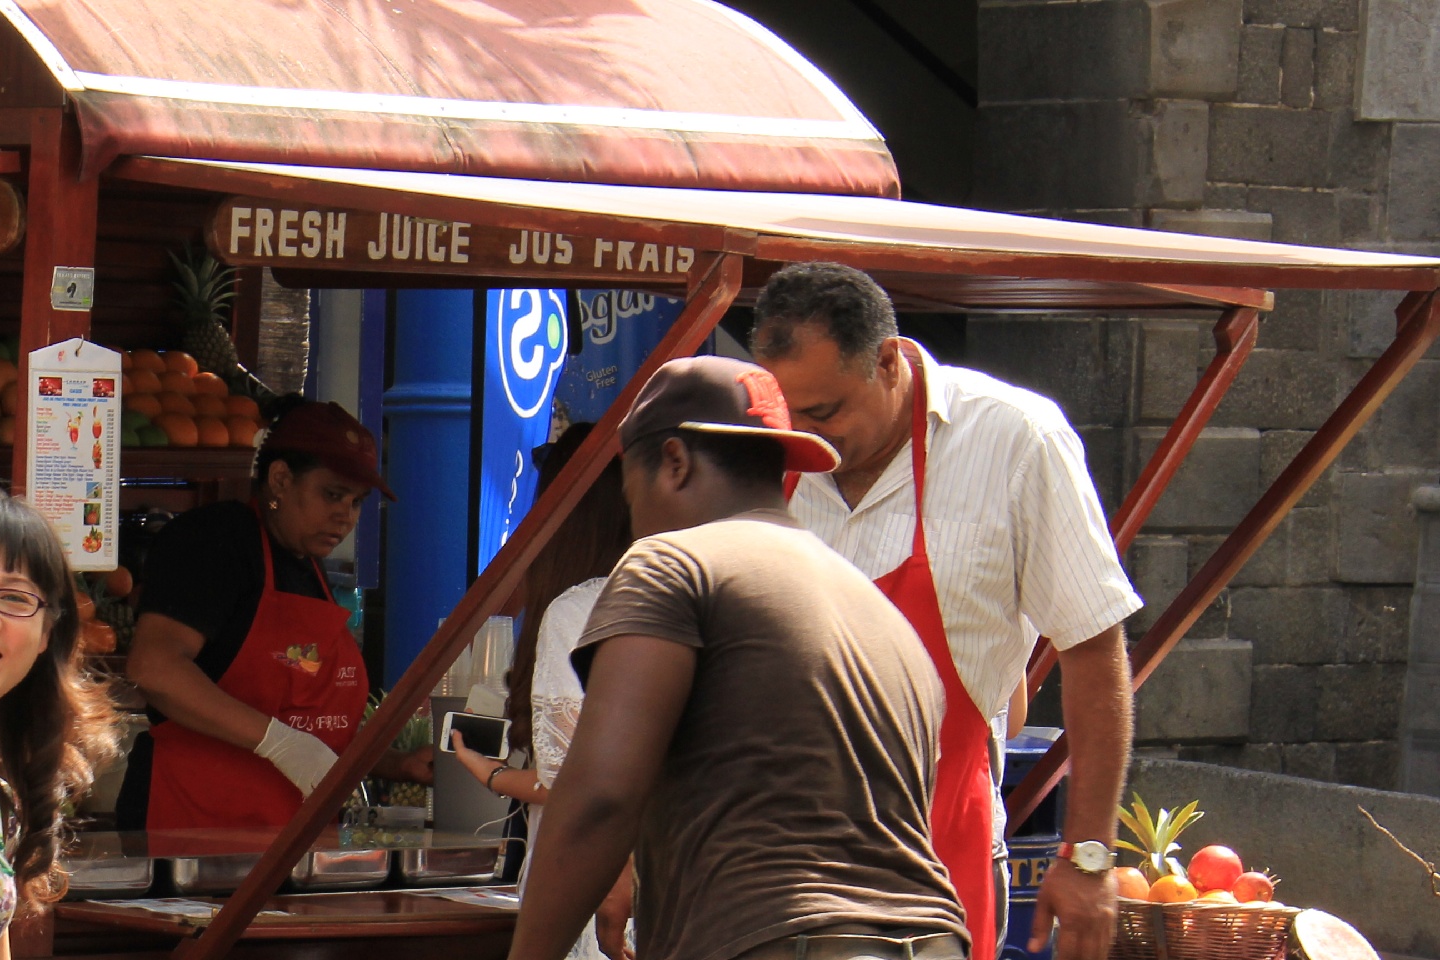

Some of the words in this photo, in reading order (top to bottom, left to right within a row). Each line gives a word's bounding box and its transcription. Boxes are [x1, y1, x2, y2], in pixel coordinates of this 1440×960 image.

[229, 207, 347, 259] FRESH
[367, 212, 471, 263] JUICE
[508, 230, 573, 265] JUS
[593, 238, 695, 273] FRAIS
[585, 365, 618, 382] Gluten
[596, 375, 616, 389] Free
